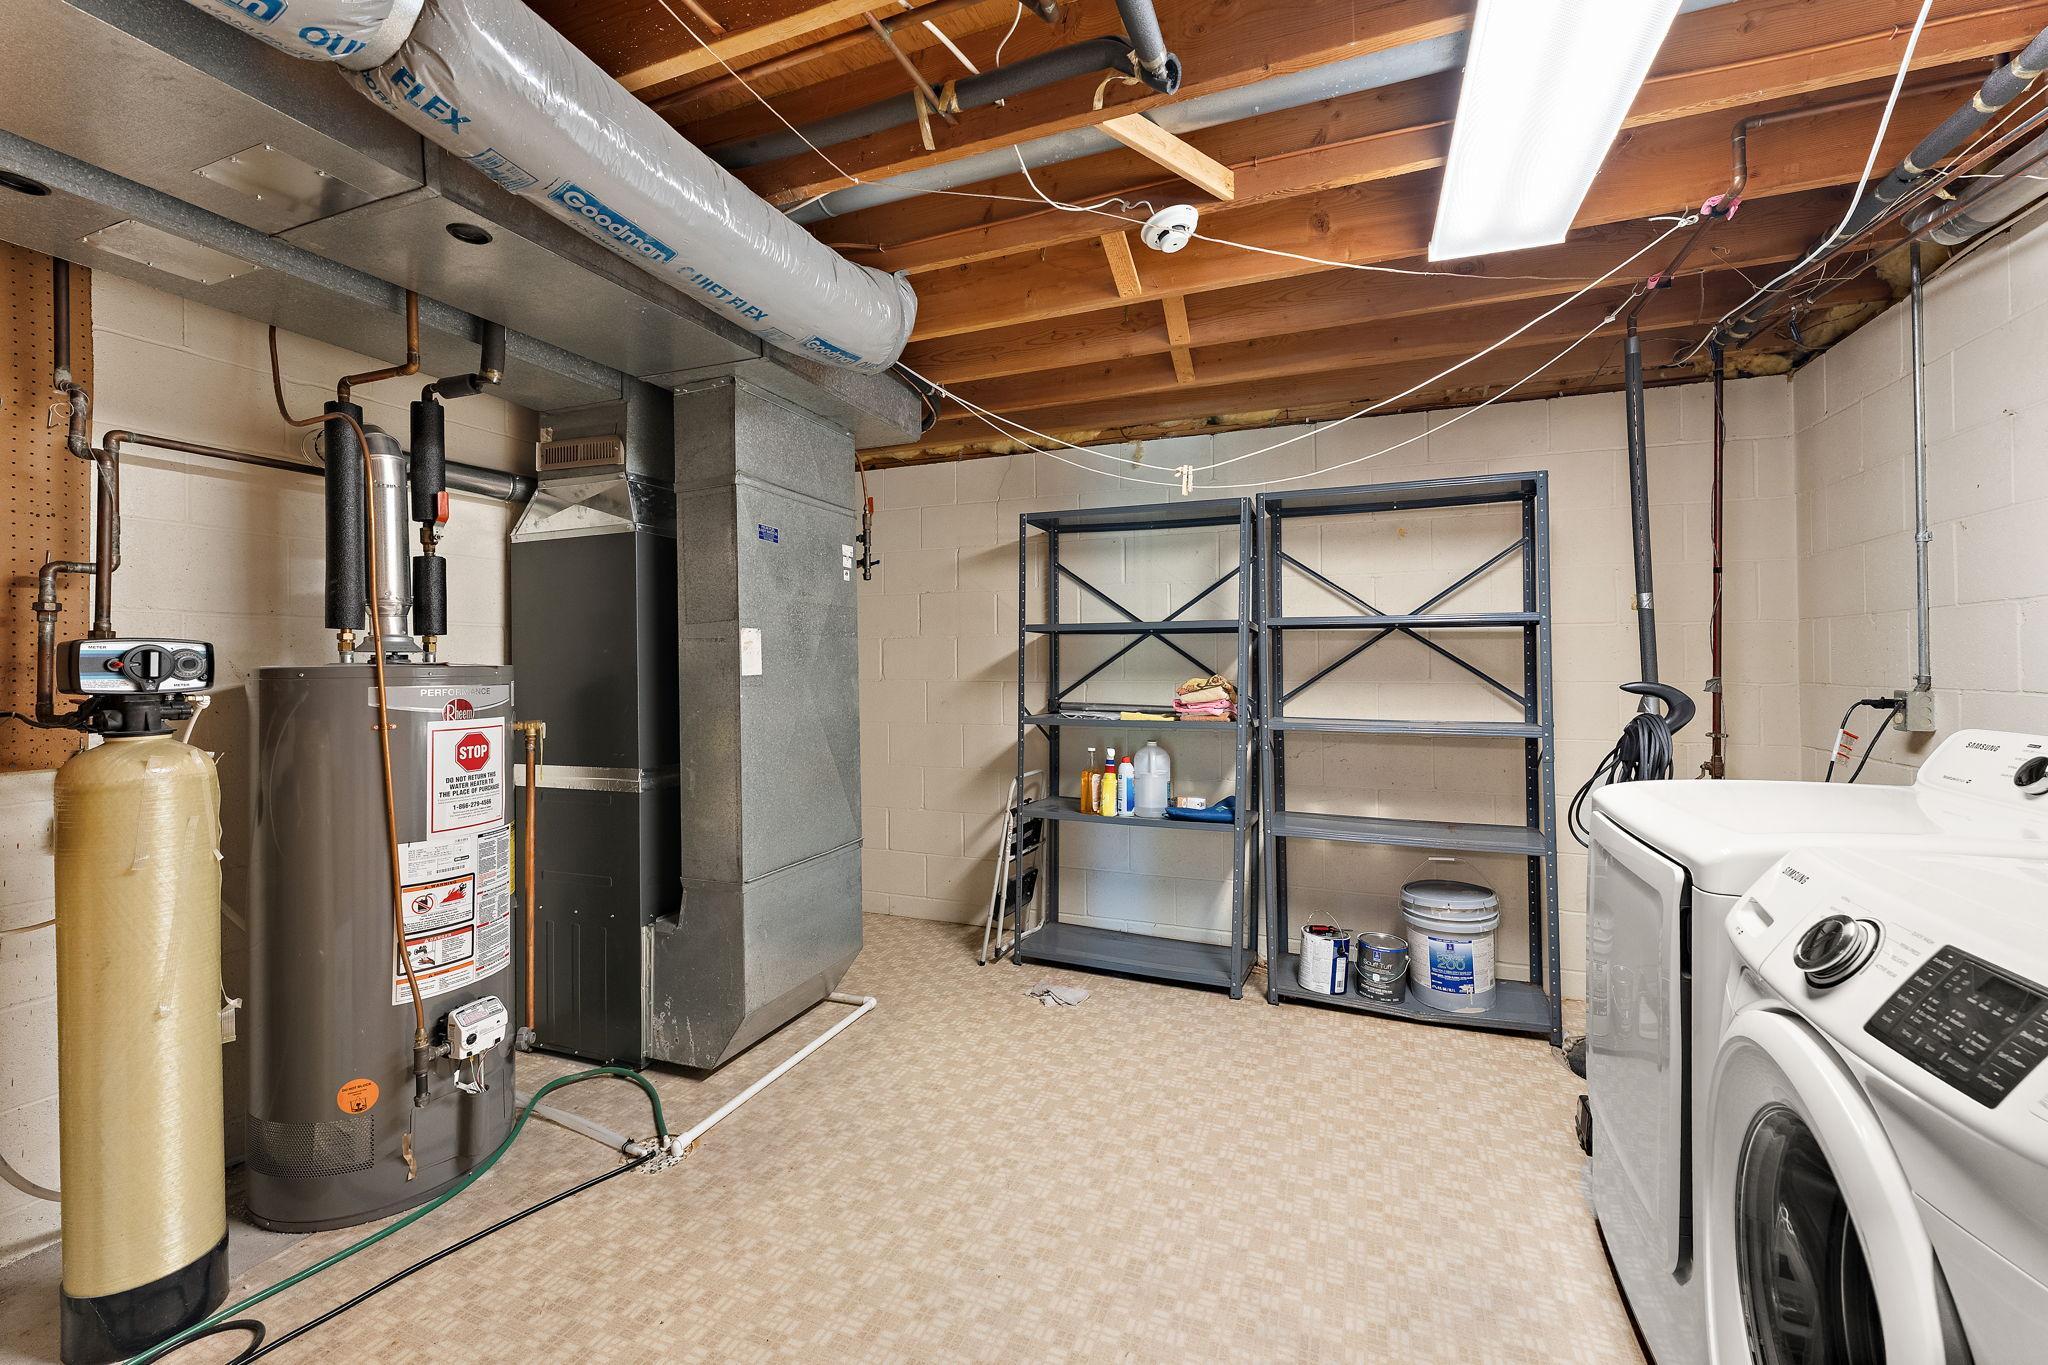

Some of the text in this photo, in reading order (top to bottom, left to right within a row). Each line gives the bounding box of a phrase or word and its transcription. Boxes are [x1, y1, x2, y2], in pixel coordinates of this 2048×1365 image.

[390, 65, 471, 135] FLEX
[563, 191, 668, 264] Goodman
[420, 688, 490, 697] PERFORMANCE
[447, 699, 473, 721] Rheem
[459, 745, 488, 760] STOP
[1966, 741, 2000, 752] SAMSUNG
[468, 773, 486, 781] RETURN
[450, 782, 469, 790] WATER
[470, 779, 488, 787] HEATER
[452, 788, 470, 796] PLACE
[479, 783, 500, 792] PURCHASE
[1782, 866, 1810, 884] SAMSUNG
[431, 880, 457, 888] WARNING
[1437, 959, 1466, 971] 200
